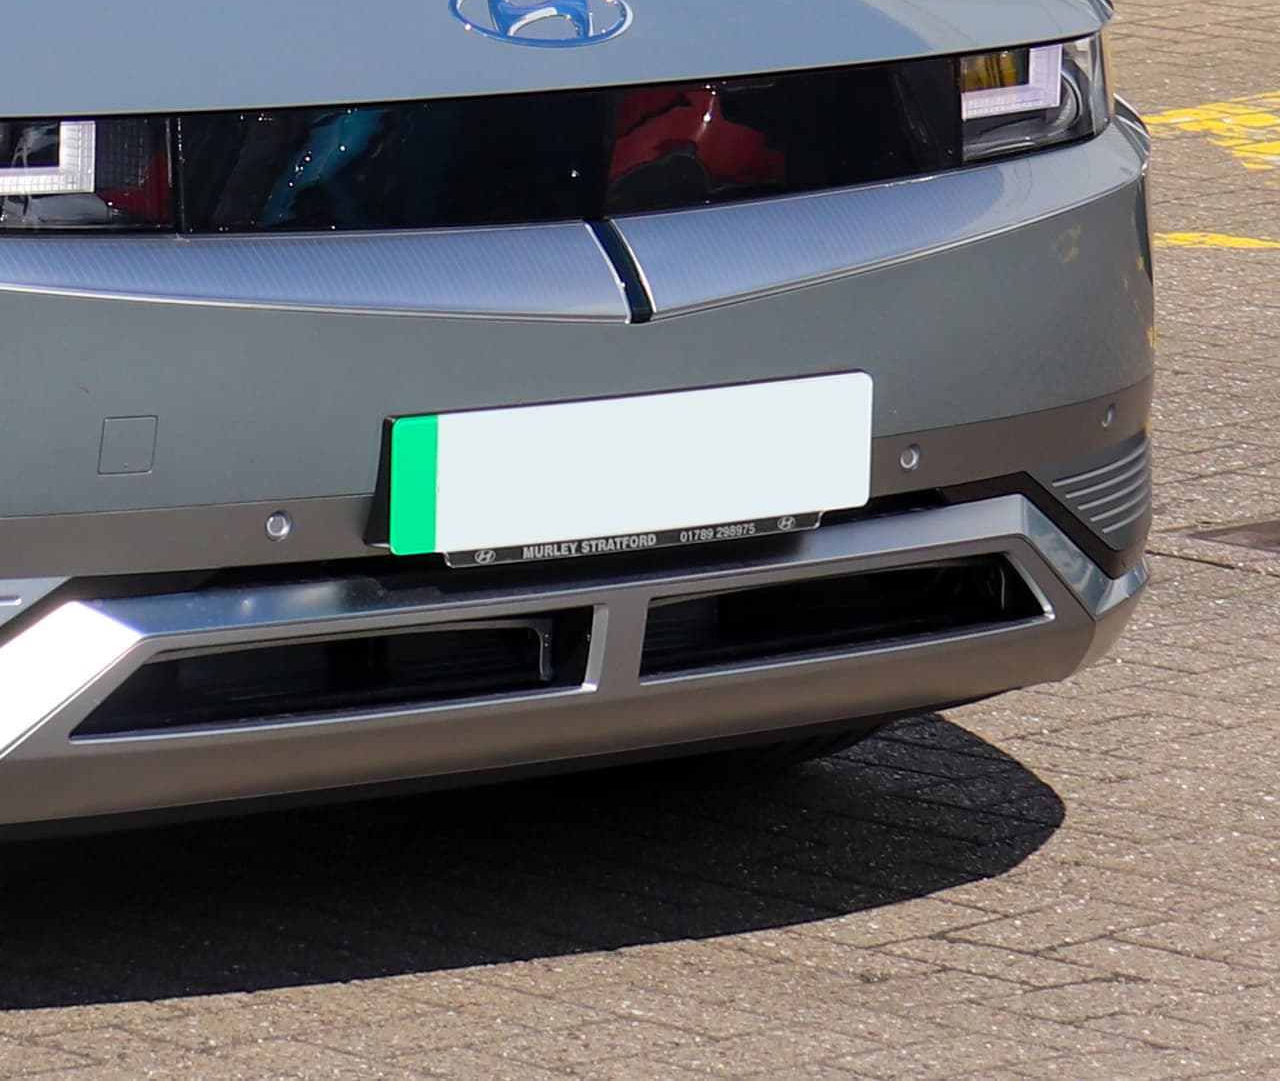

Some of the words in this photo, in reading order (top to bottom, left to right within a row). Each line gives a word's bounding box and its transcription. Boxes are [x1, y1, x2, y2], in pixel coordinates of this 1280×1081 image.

[523, 542, 579, 560] MURLEY
[581, 533, 657, 554] STRATFORD
[680, 527, 714, 543] 01789
[716, 523, 756, 539] 298975
